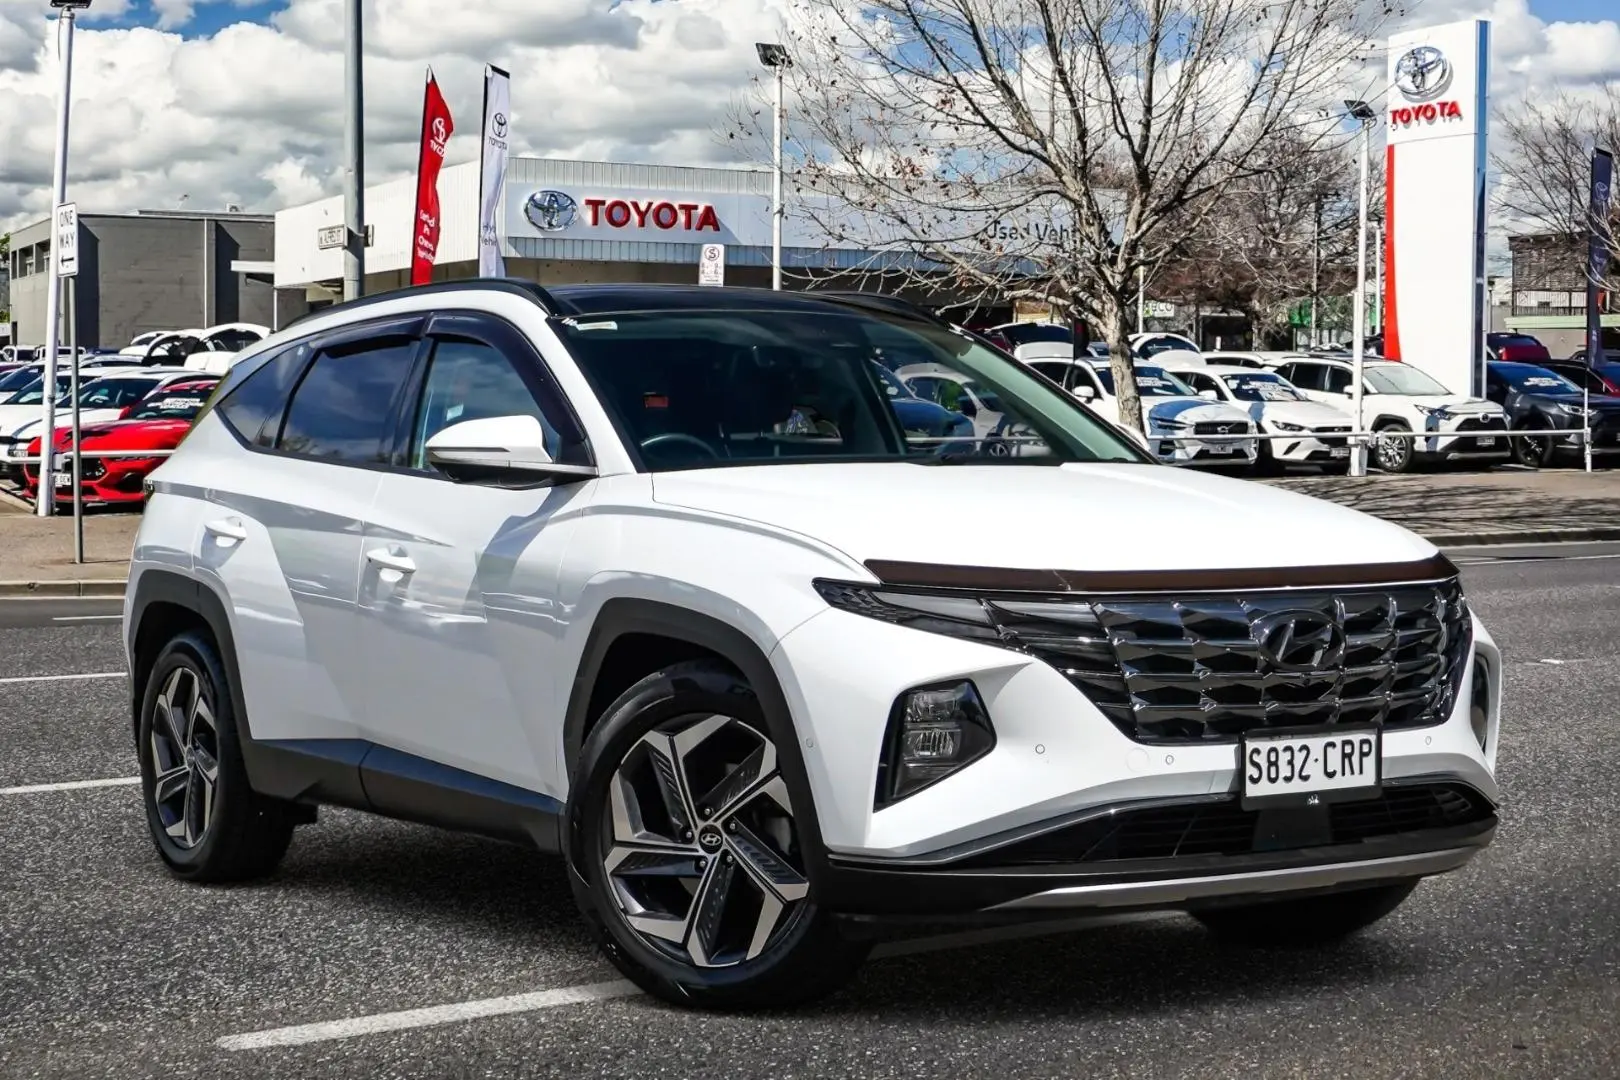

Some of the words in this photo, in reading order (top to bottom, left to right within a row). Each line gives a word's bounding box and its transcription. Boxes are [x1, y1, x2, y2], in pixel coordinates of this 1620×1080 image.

[1389, 101, 1462, 125] TOYOTA
[60, 210, 74, 228] ONE
[584, 198, 720, 232] TOYOTA
[59, 231, 75, 249] WAY
